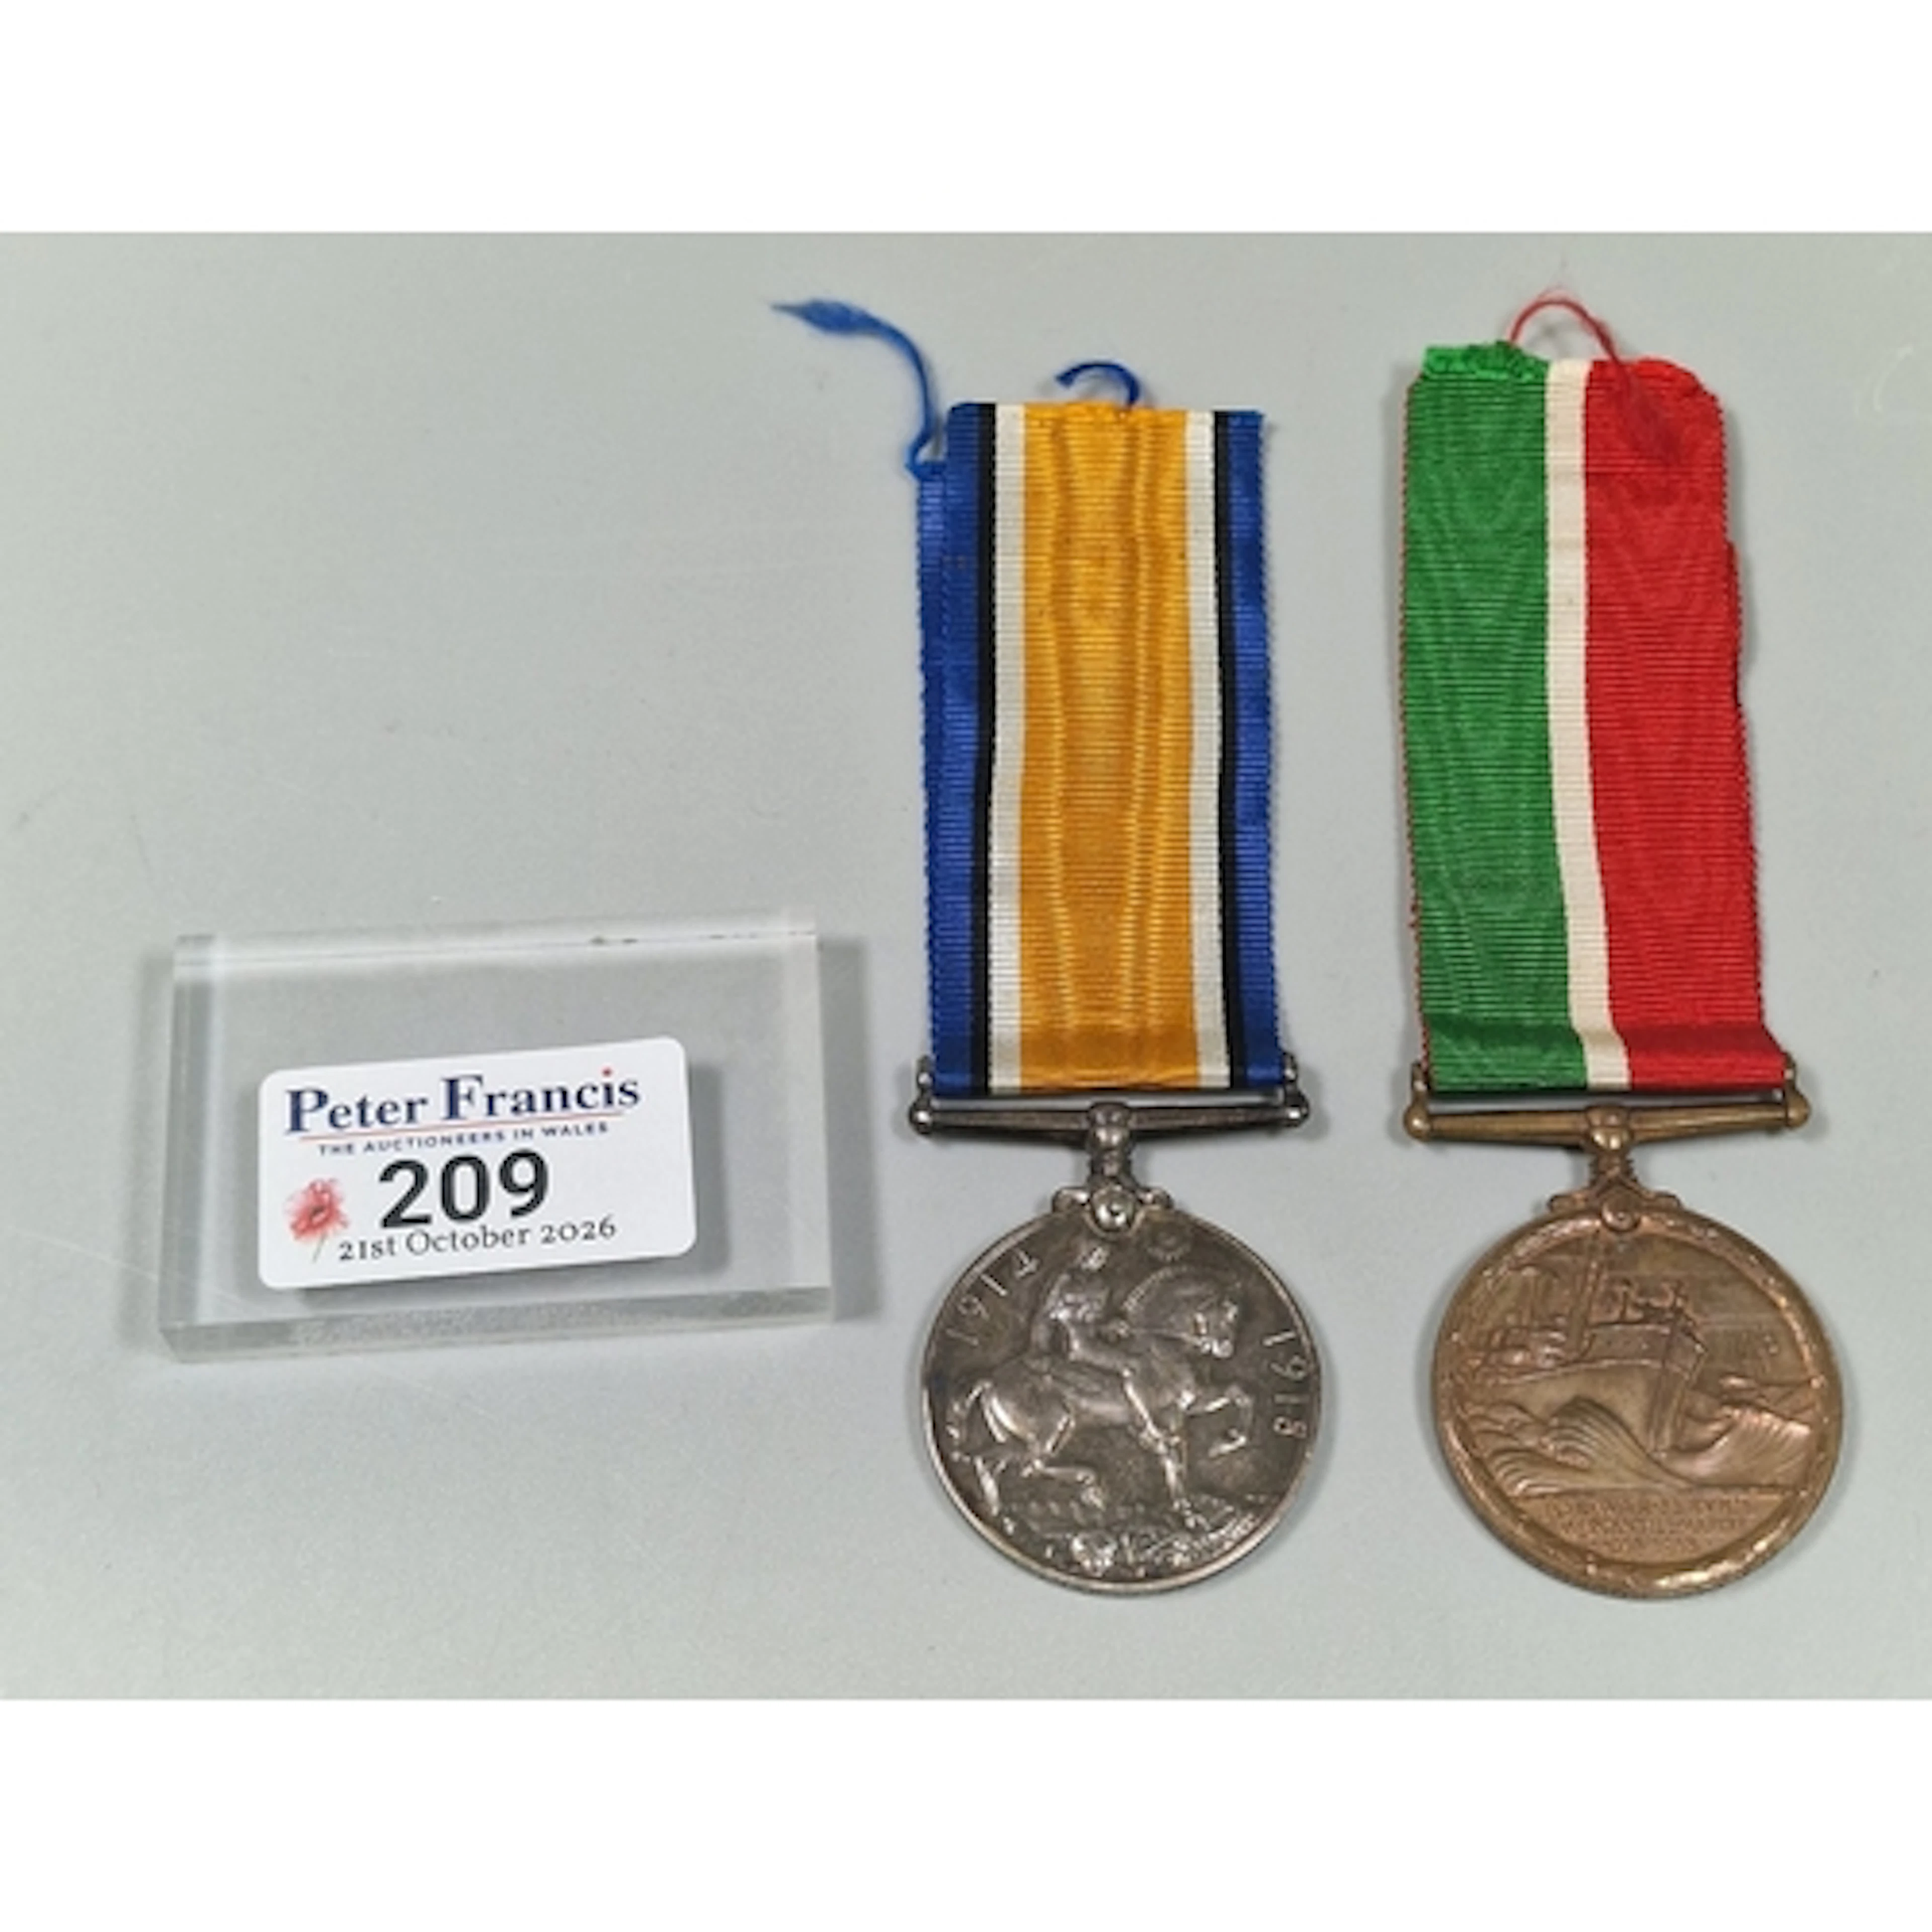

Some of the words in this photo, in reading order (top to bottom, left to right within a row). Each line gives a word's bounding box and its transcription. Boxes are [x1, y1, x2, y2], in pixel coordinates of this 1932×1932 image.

[285, 1088, 428, 1134] Peter
[441, 1067, 640, 1122] Francis
[318, 1143, 355, 1156] THE
[363, 1131, 505, 1154] AUCTIONEERS
[514, 1128, 534, 1141] IN
[542, 1121, 610, 1138] WALES
[379, 1149, 548, 1228] 209
[339, 1235, 395, 1260] 21st
[406, 1225, 531, 1257] October
[541, 1216, 616, 1245] 2026
[944, 1248, 1040, 1346] 1914
[1262, 1328, 1308, 1439] 1918
